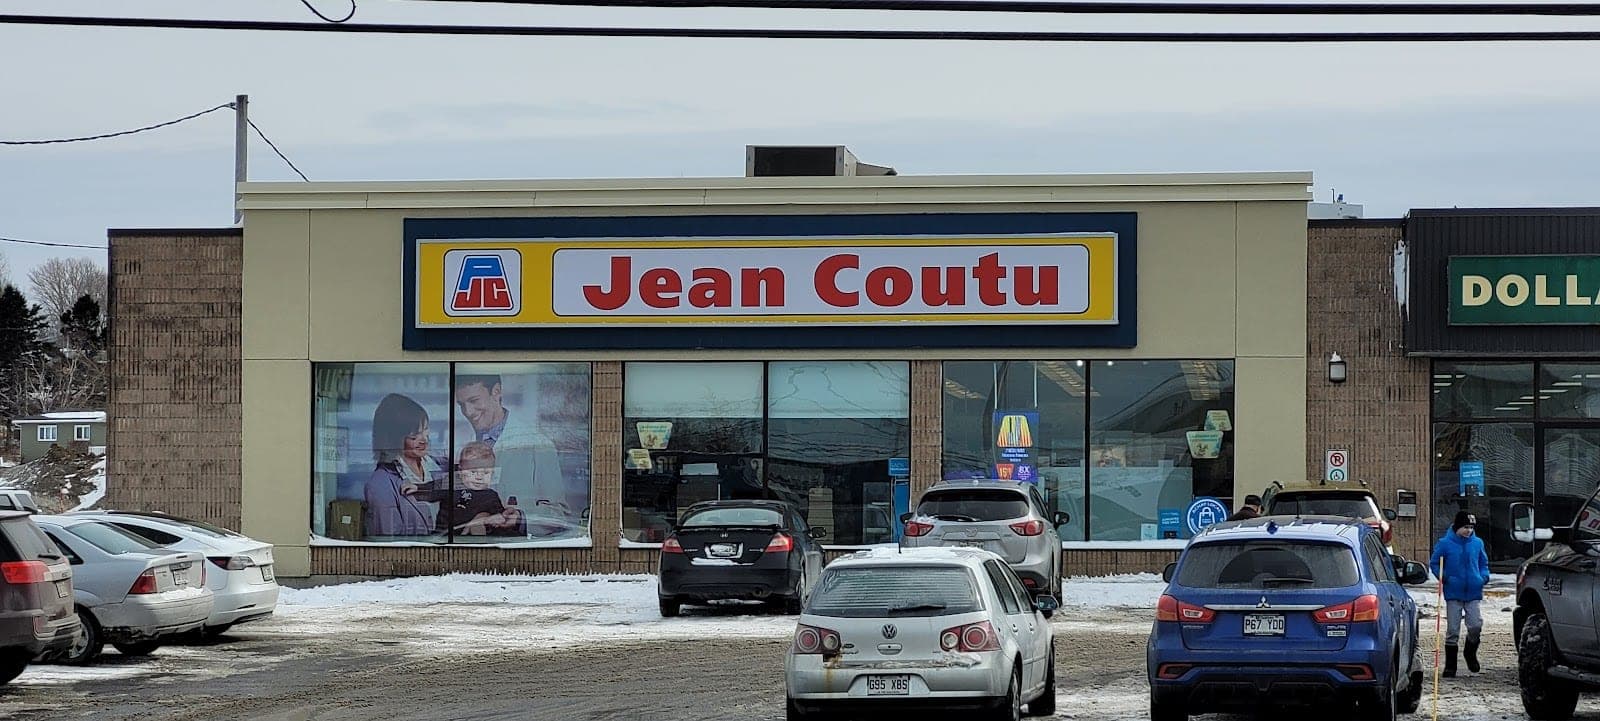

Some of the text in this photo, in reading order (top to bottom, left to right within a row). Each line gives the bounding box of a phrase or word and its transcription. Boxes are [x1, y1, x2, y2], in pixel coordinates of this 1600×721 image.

[582, 251, 1060, 311] Jean Coutu
[1462, 273, 1600, 307] DOLL
[1245, 618, 1262, 630] P67
[869, 679, 886, 690] G95
